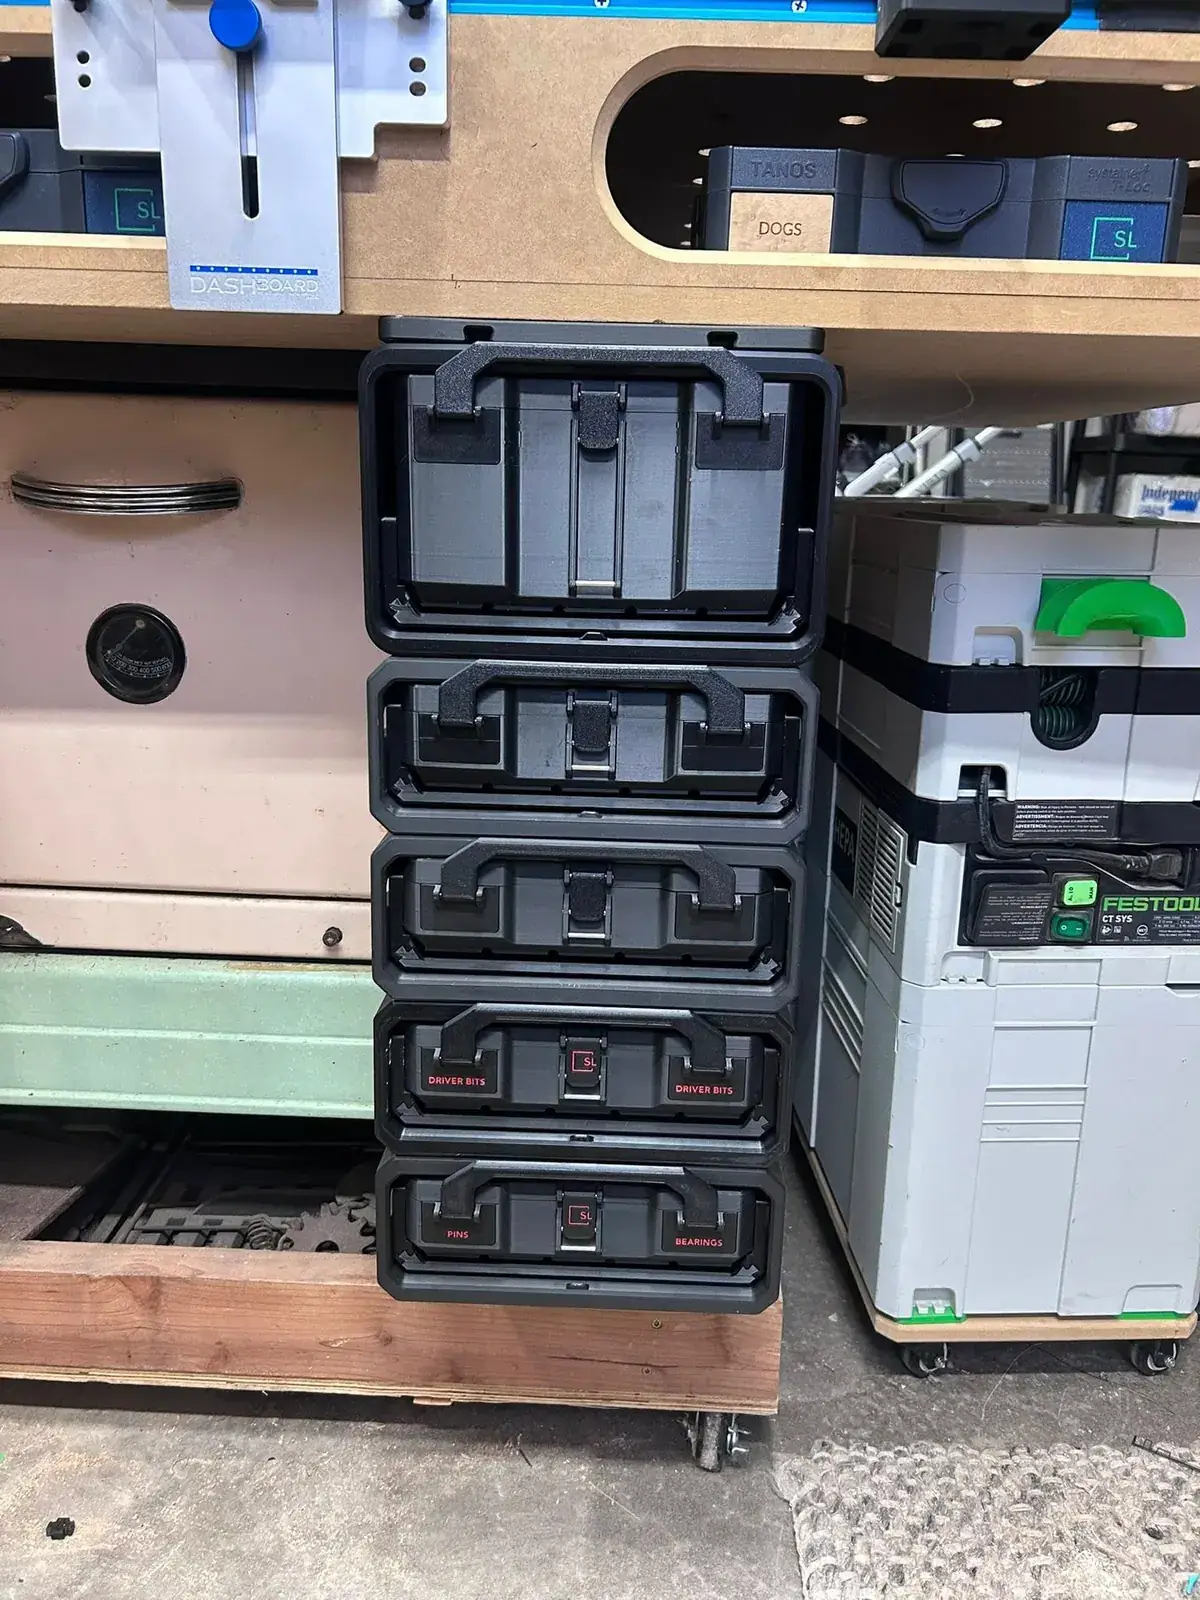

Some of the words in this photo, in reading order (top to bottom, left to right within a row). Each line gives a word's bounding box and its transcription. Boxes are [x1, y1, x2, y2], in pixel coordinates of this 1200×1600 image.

[750, 160, 817, 179] TANOS
[138, 201, 160, 219] SL
[759, 221, 803, 236] DOGS
[1114, 230, 1137, 248] SL
[190, 276, 319, 295] DASHBOARD
[834, 817, 855, 861] HEPA
[1102, 914, 1115, 923] CT
[1115, 914, 1133, 923] SYS
[583, 1057, 597, 1067] SL
[428, 1075, 465, 1086] DRIVER
[466, 1076, 486, 1087] BITS
[675, 1084, 711, 1094] DRIVER
[713, 1086, 733, 1095] BITS
[580, 1211, 593, 1220] SL
[447, 1230, 469, 1239] PINS
[675, 1237, 723, 1247] BEARINGS
